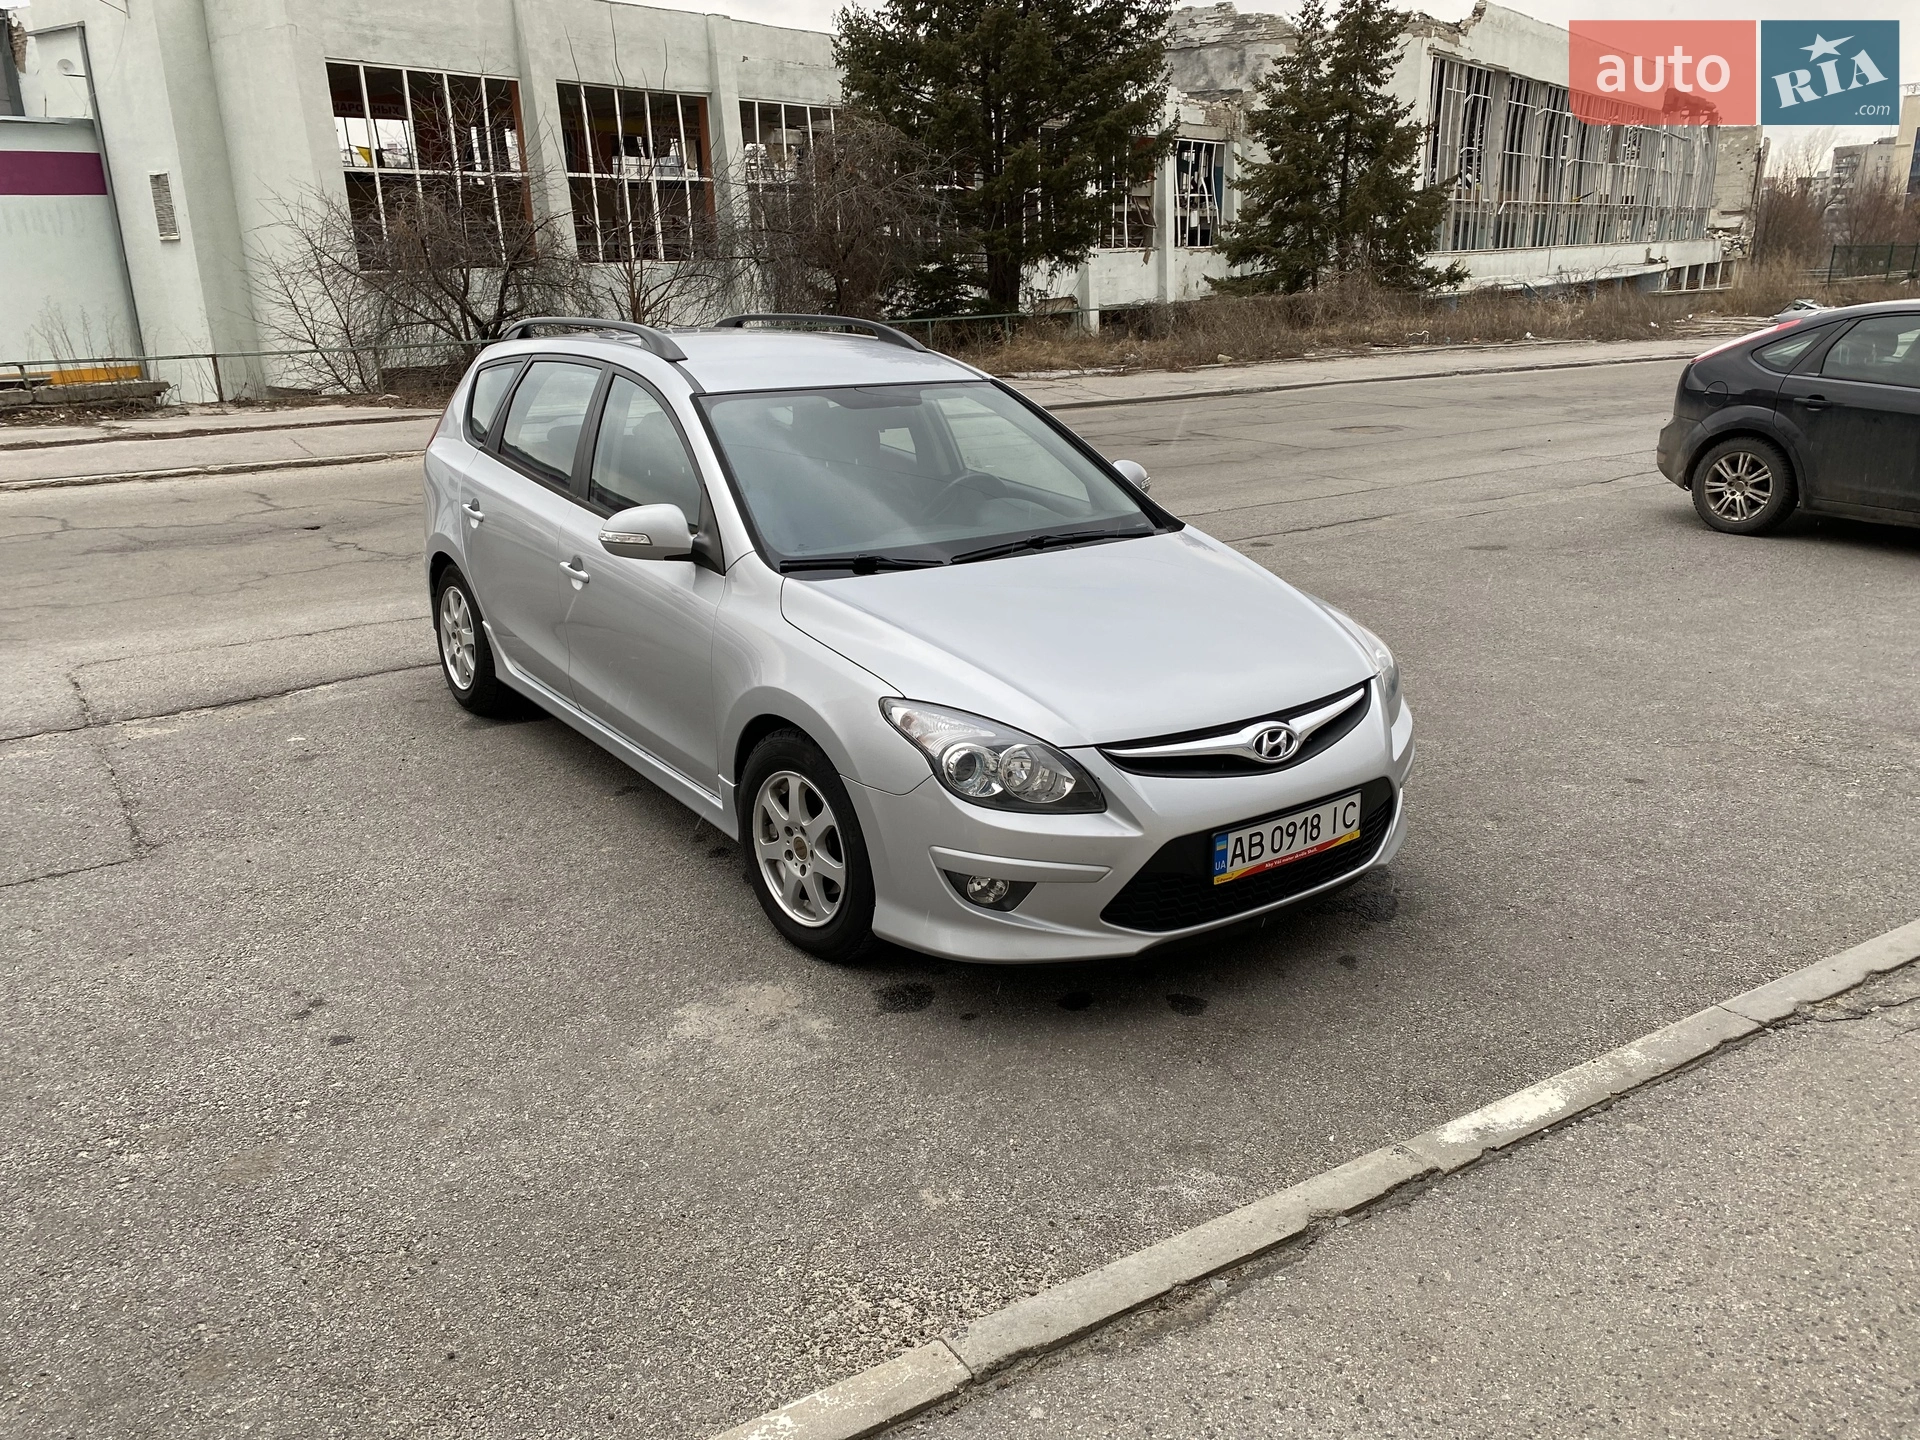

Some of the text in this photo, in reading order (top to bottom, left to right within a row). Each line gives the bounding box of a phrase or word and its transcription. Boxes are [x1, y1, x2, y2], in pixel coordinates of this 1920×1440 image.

[333, 102, 400, 115] НАРОНЫХ
[1230, 831, 1265, 868] AB
[1270, 813, 1321, 854] 0918
[1215, 859, 1226, 870] UA
